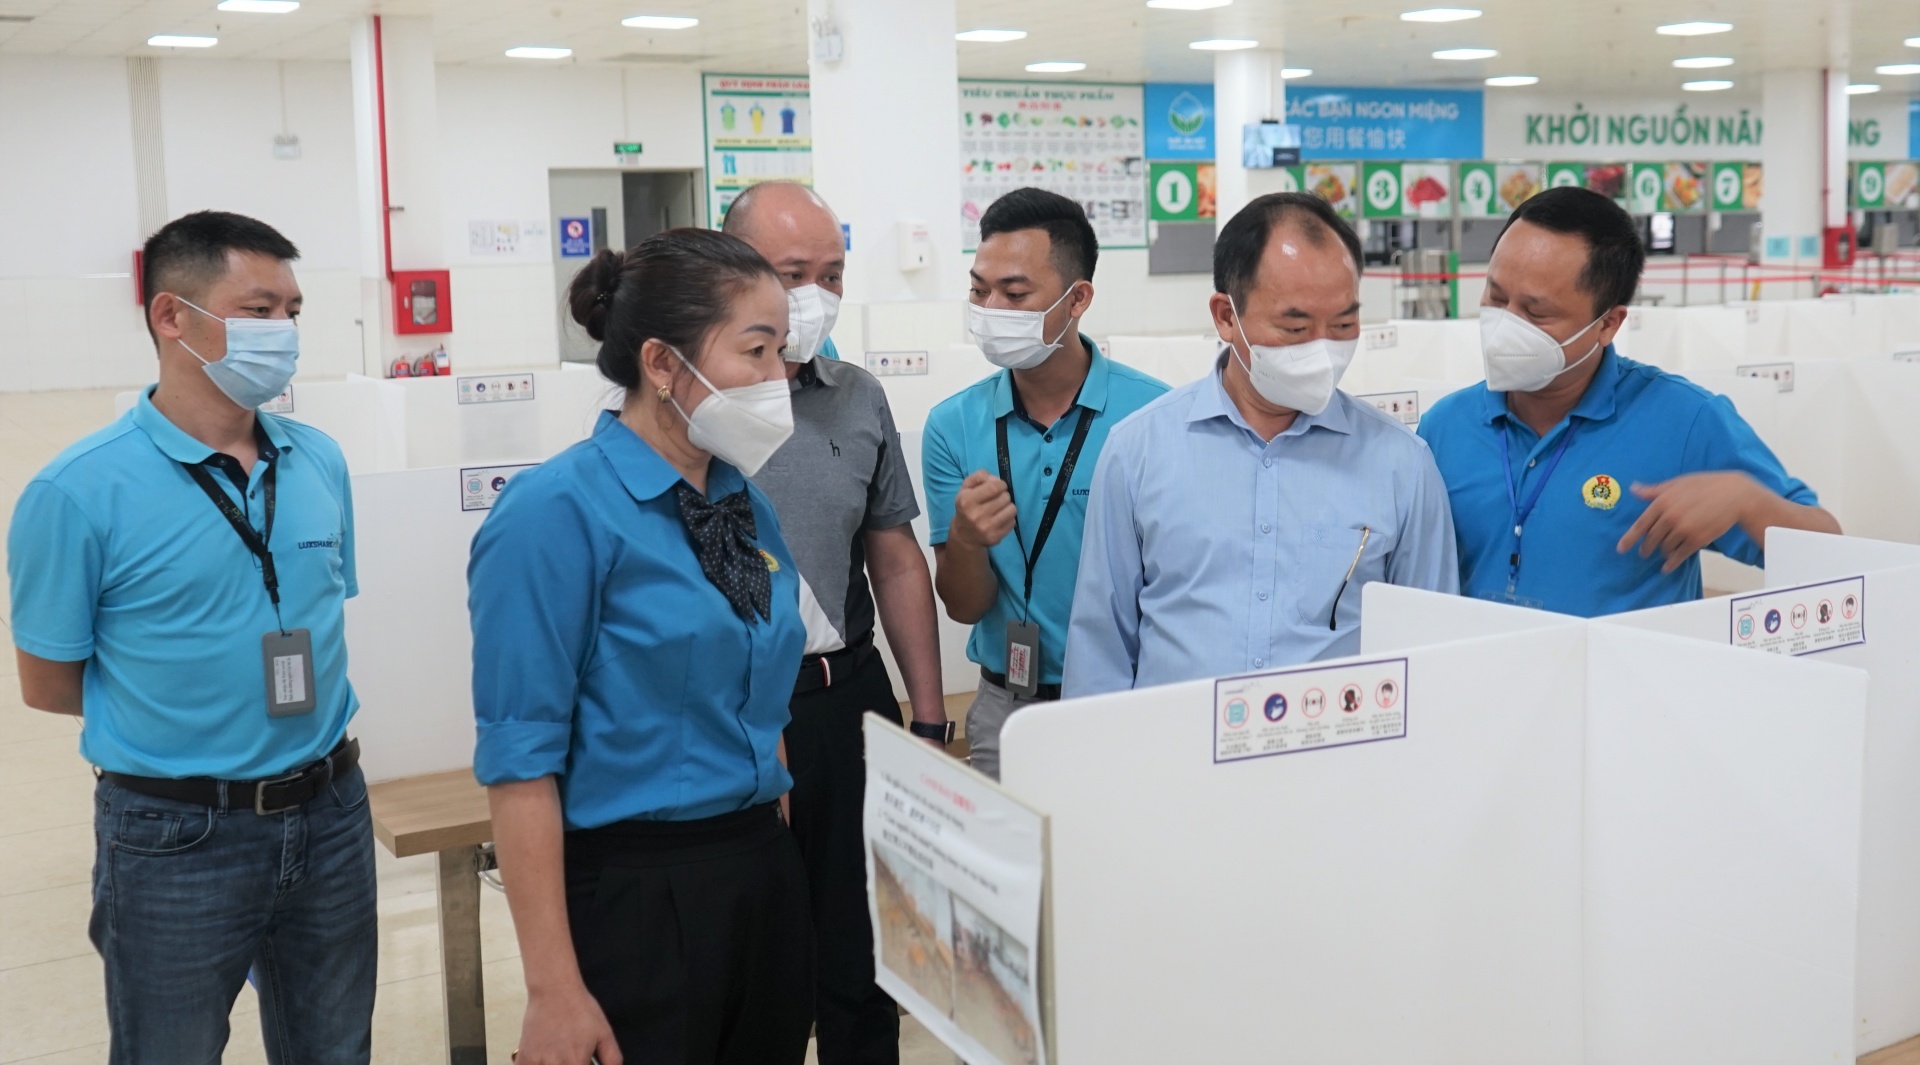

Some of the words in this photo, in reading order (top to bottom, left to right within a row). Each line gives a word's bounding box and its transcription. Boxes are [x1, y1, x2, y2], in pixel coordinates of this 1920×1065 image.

[1356, 101, 1405, 118] NGON
[1409, 99, 1459, 122] MIỆNG
[1525, 102, 1599, 145] KHỞI
[1301, 126, 1407, 150] 您用餐愉快
[1168, 182, 1178, 204] 1
[1375, 178, 1391, 201] 3
[1641, 178, 1653, 198] 6
[1722, 176, 1733, 196] 7
